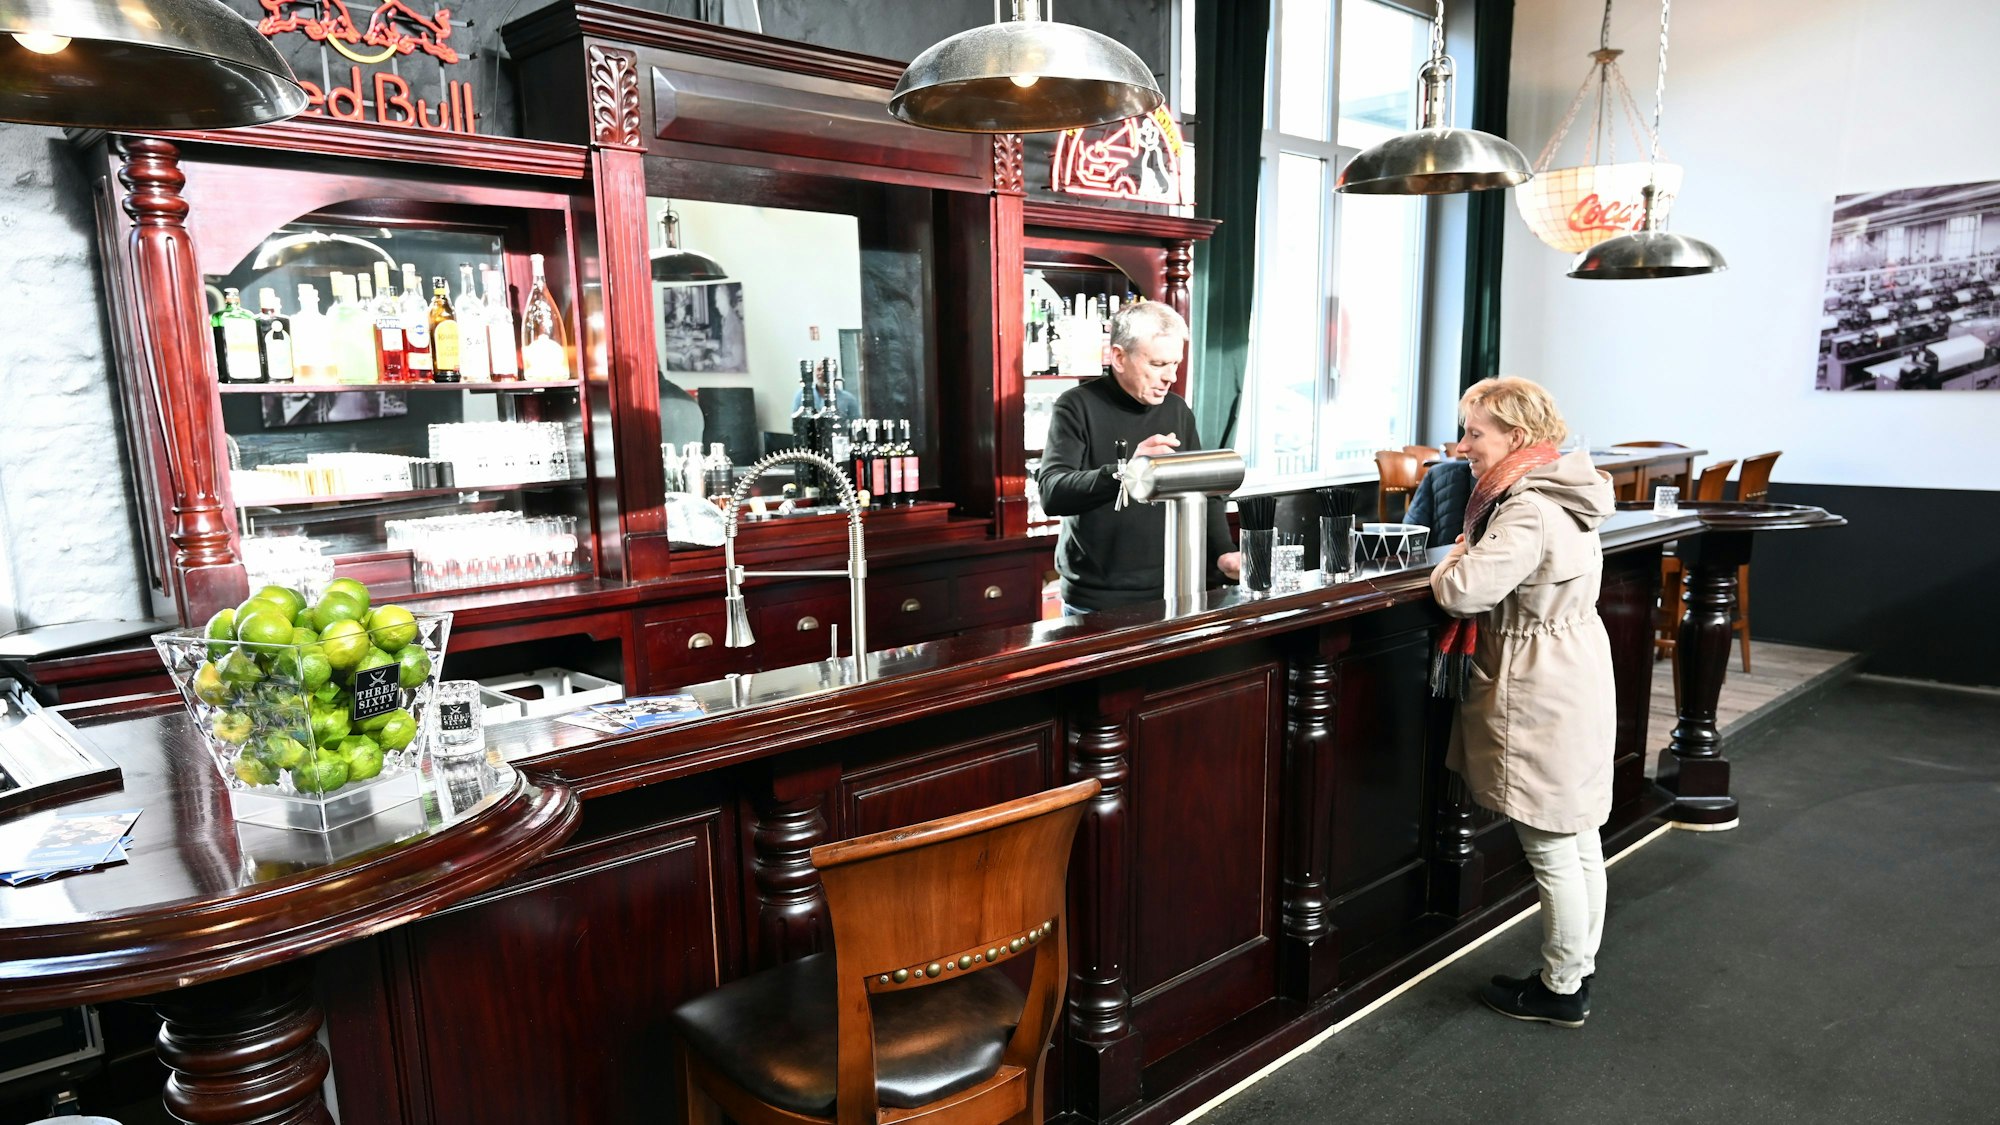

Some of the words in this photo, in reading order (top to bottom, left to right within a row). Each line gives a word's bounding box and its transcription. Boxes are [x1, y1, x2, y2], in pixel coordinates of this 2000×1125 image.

[374, 72, 476, 134] Bull
[357, 682, 398, 701] THREE
[358, 692, 395, 710] SIXTY
